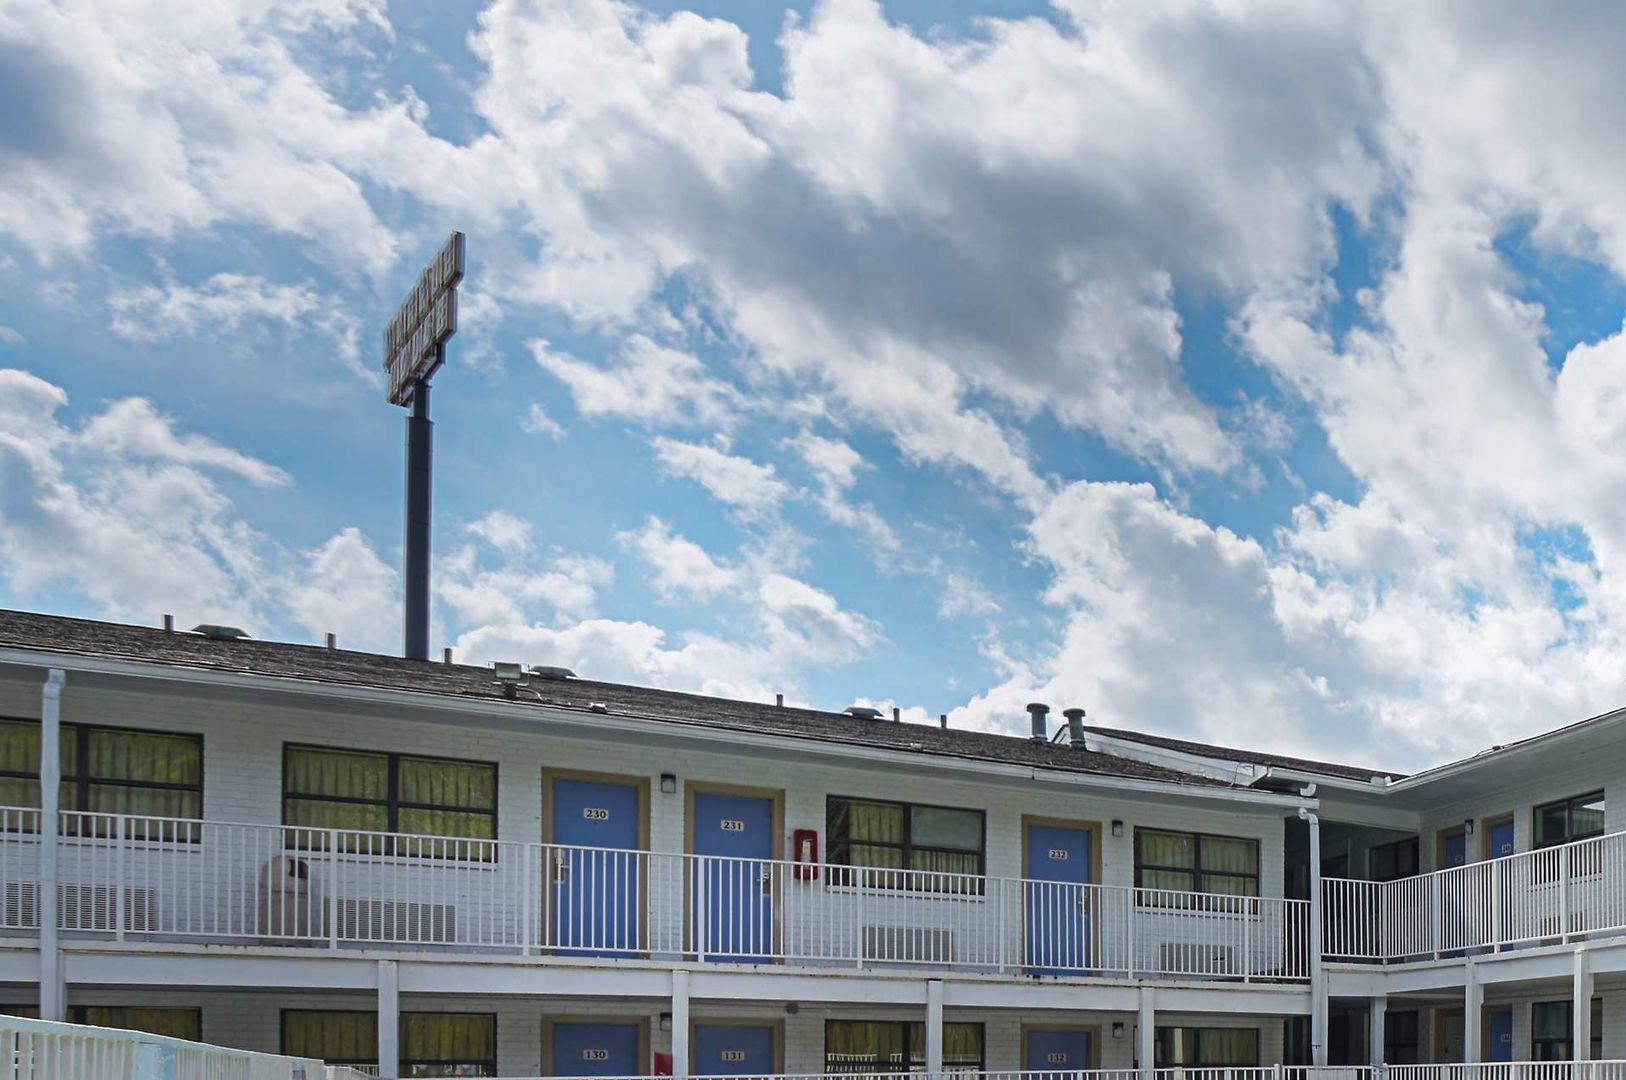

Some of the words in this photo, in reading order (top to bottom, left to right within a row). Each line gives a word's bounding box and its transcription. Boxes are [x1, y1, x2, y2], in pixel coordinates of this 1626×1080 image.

[586, 809, 607, 819] 230
[724, 821, 742, 830] 231
[1051, 850, 1066, 859] 232
[586, 1051, 606, 1059] 130
[724, 1051, 742, 1060] 131
